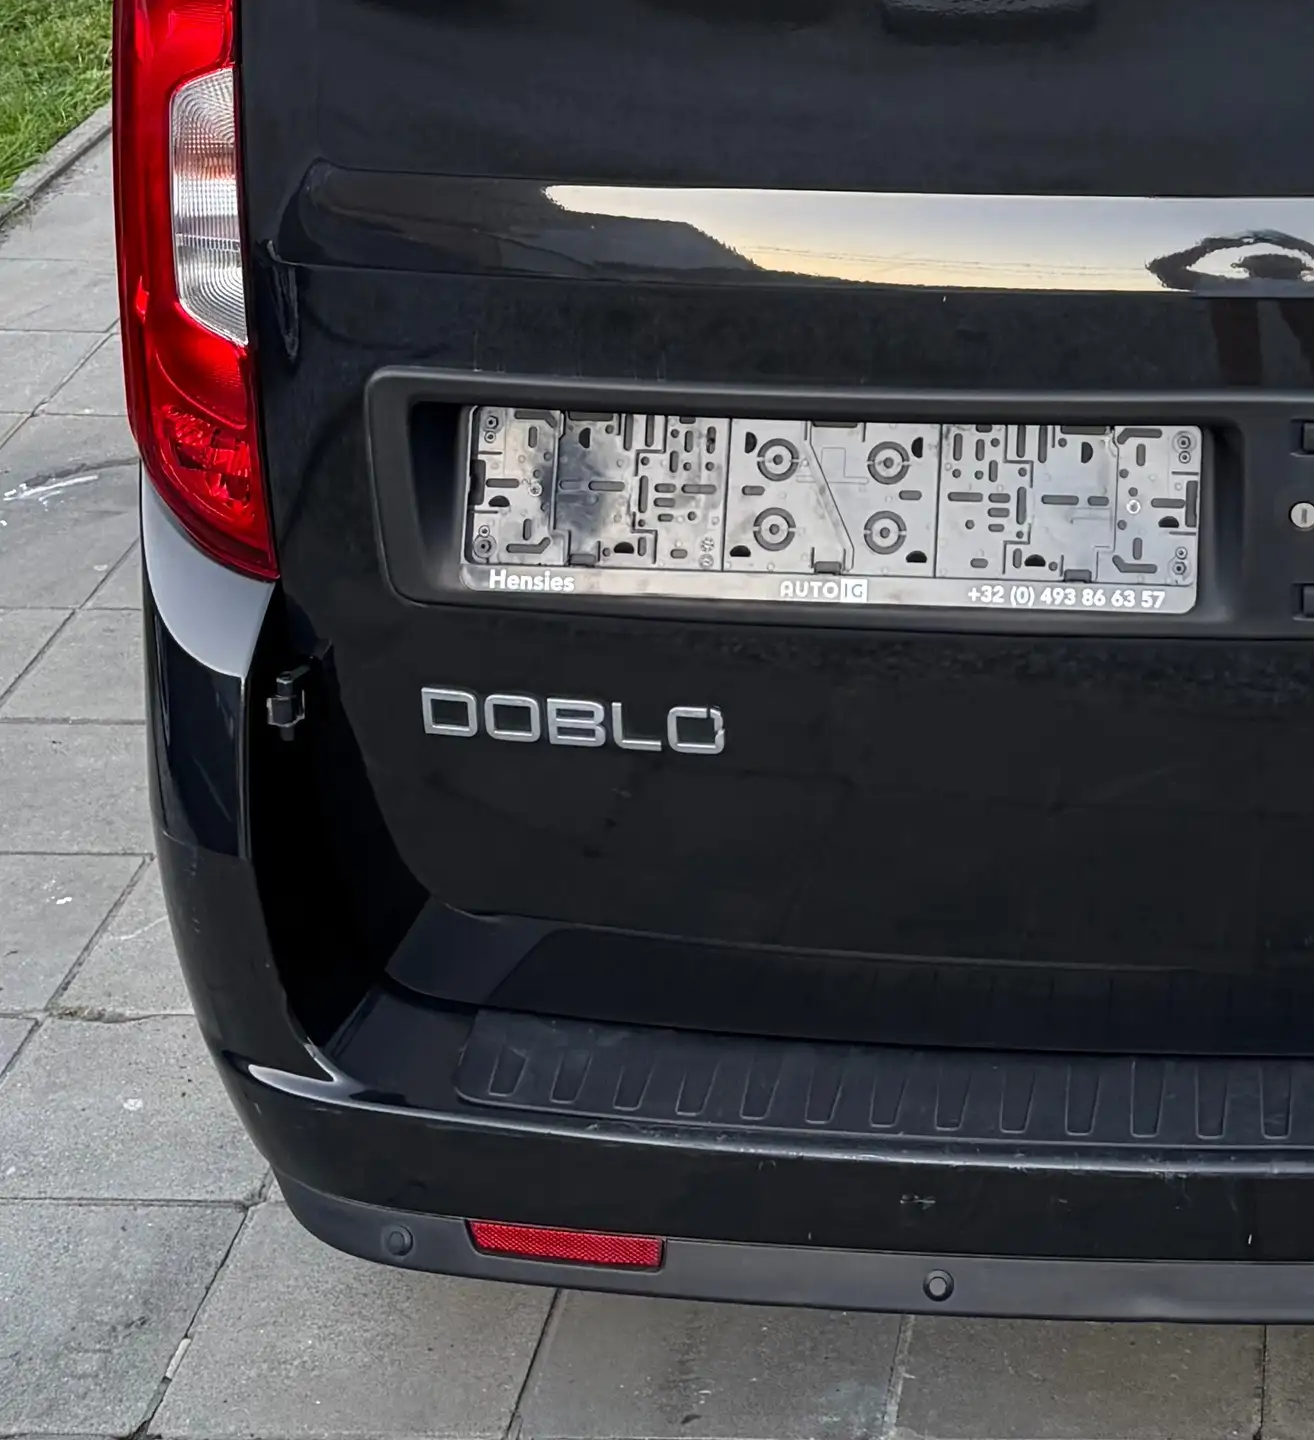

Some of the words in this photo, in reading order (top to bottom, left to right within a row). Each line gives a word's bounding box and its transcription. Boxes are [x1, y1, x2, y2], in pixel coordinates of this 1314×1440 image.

[489, 568, 575, 592] Hensies
[780, 581, 838, 599] AUTO
[842, 580, 866, 600] IG
[968, 586, 1004, 603] +32
[1009, 587, 1035, 607] (0)
[1040, 588, 1077, 606] 493
[1081, 589, 1106, 607] 86
[1111, 591, 1135, 608] 63
[1140, 592, 1166, 609] 57
[421, 686, 727, 754] DOBLO
